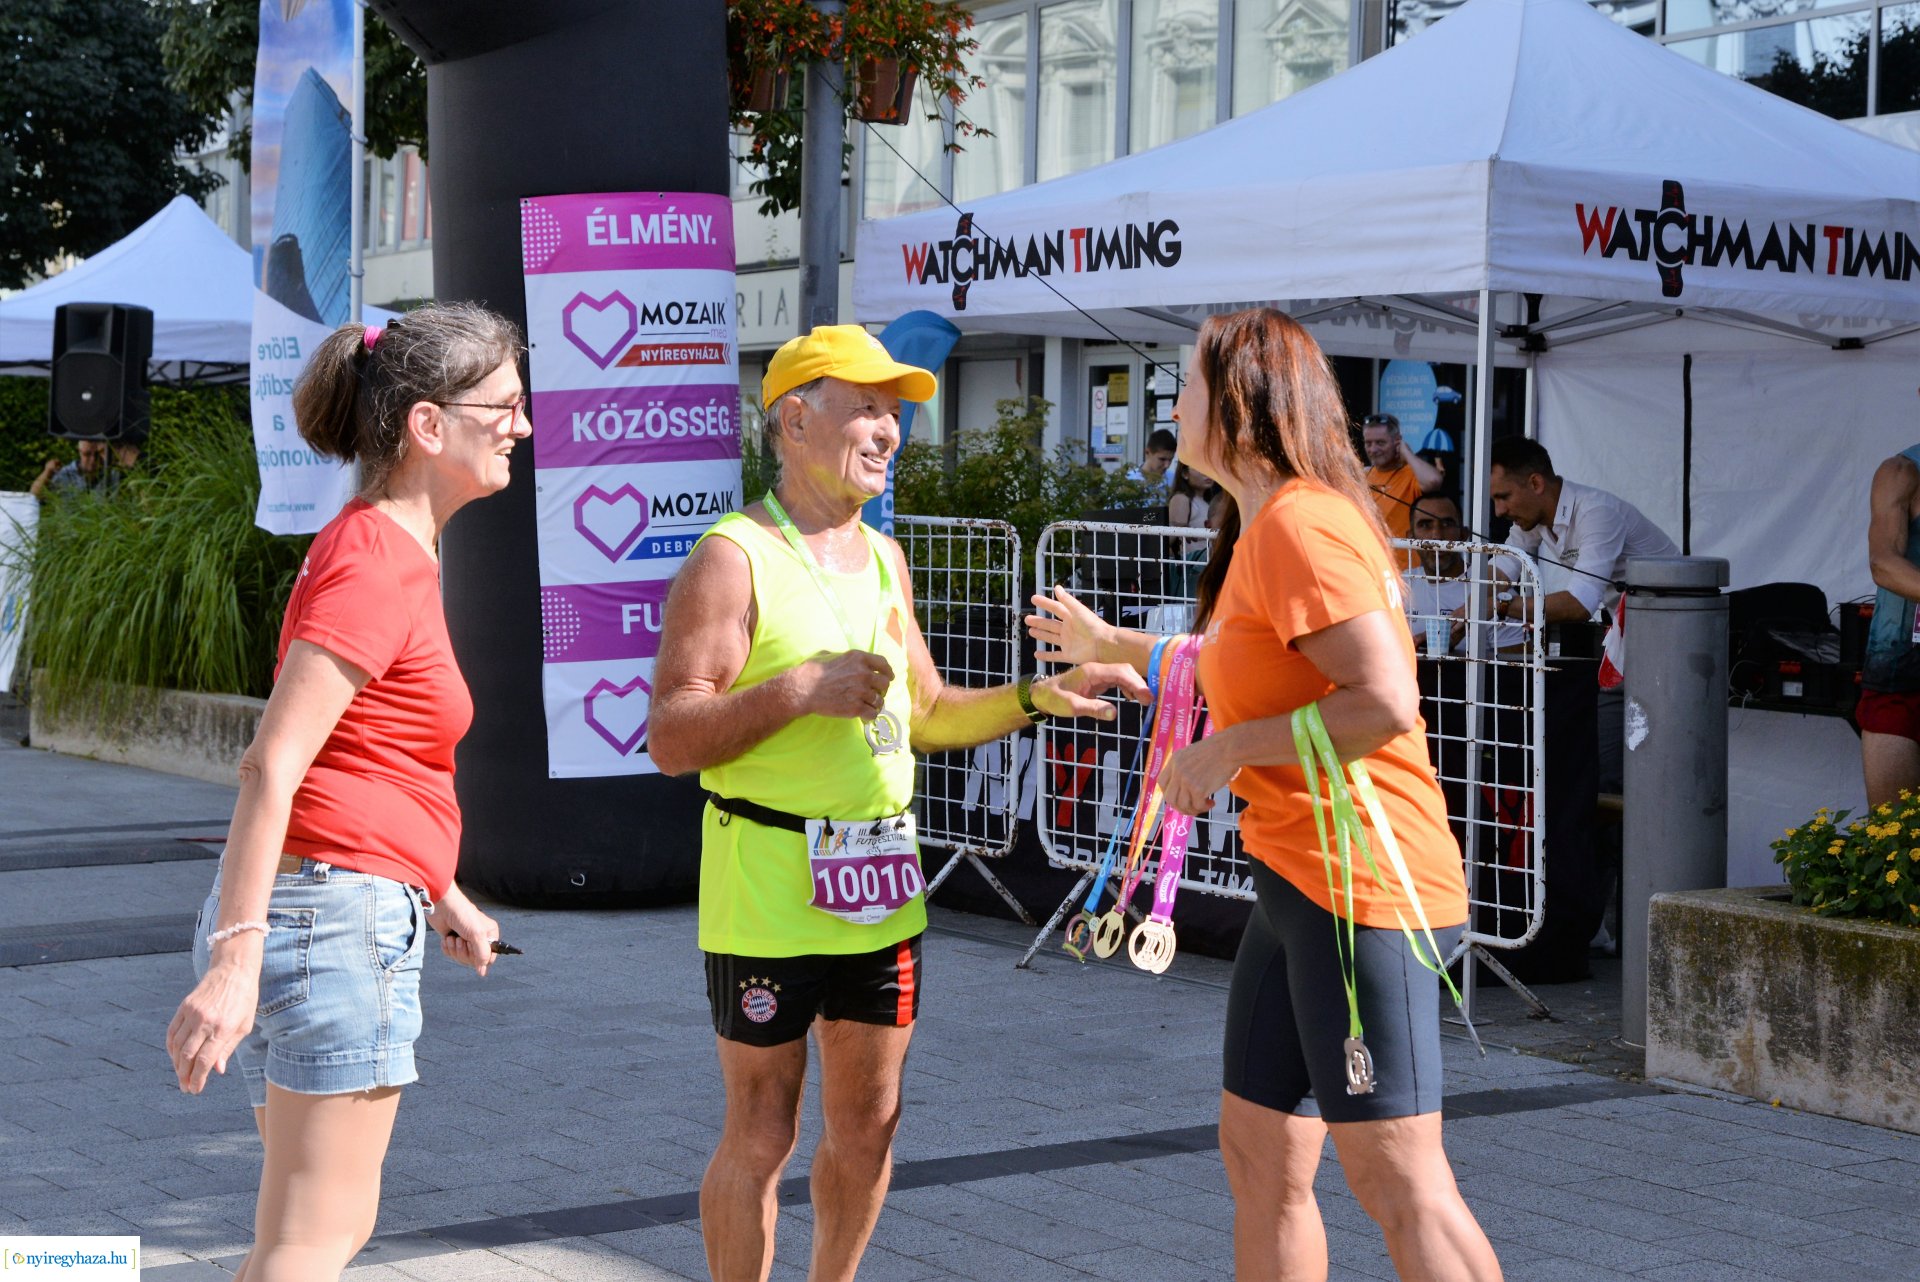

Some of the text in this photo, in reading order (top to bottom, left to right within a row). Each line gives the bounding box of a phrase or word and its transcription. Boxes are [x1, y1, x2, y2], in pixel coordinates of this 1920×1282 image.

[586, 206, 716, 246] ÉLMÉNY.
[1575, 203, 1920, 281] WATCHMAN TIMIN
[902, 219, 1182, 286] WATCHMAN TIMING
[640, 302, 726, 325] MOZAIK
[736, 288, 789, 328] RIA
[641, 346, 719, 362] NYÍREGYHÁZA
[572, 399, 734, 442] KÖZÖSSÉG.
[652, 491, 734, 518] MOZAIK
[652, 539, 698, 554] DEBR
[621, 602, 664, 634] FU
[817, 862, 922, 904] 10010
